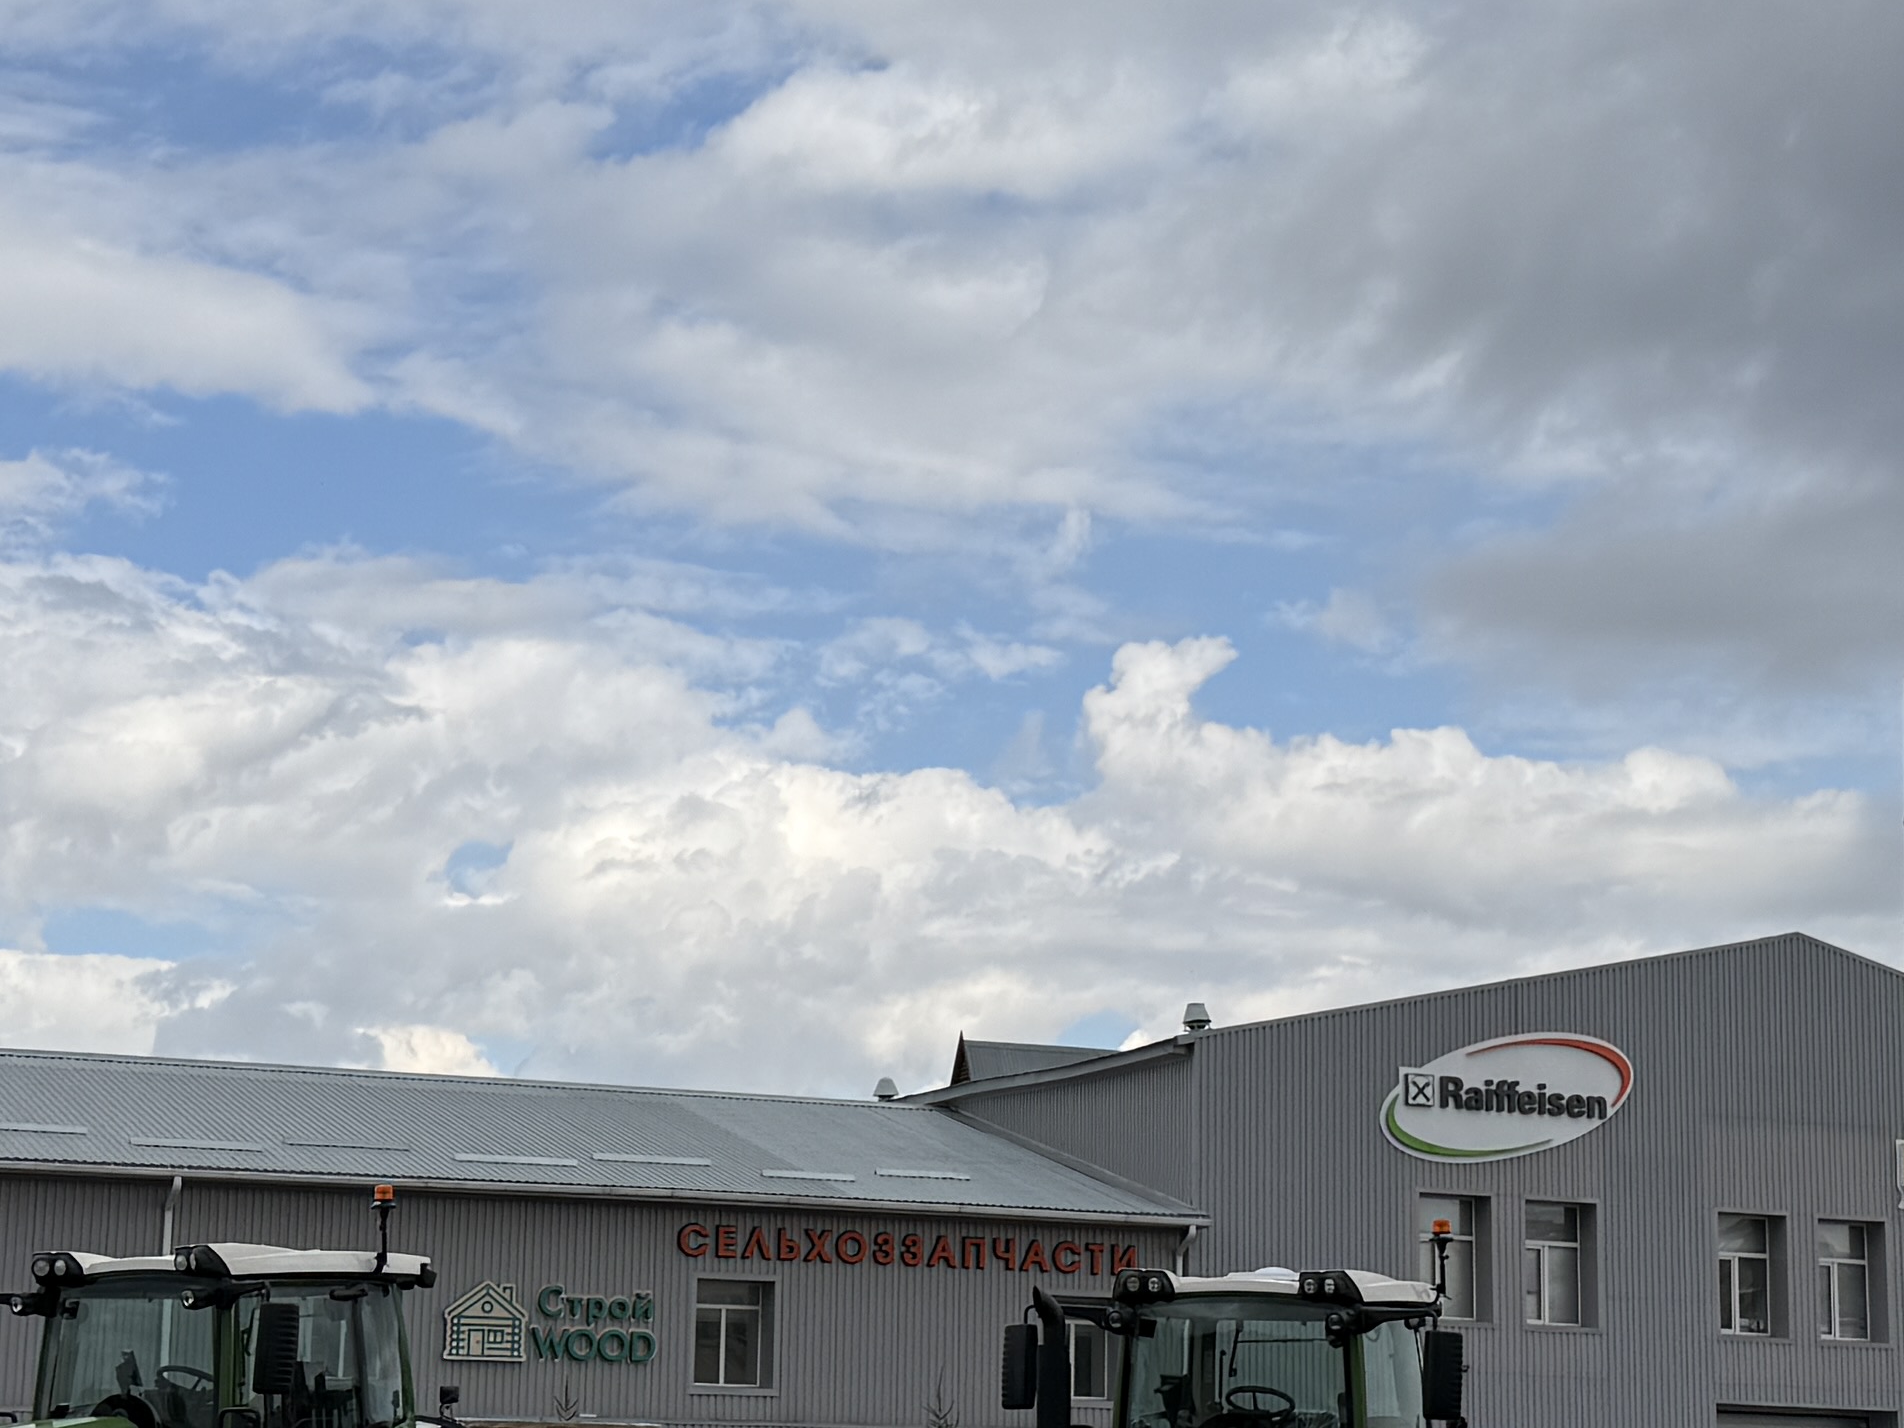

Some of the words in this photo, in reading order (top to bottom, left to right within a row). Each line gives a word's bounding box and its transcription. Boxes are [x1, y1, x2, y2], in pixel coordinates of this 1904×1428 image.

[1439, 1076, 1607, 1120] Raiffeisen
[677, 1222, 1138, 1275] СЕЛЬХОЗЗАПЧАСТИ
[537, 1285, 657, 1326] Строй
[531, 1325, 657, 1364] WOOD
